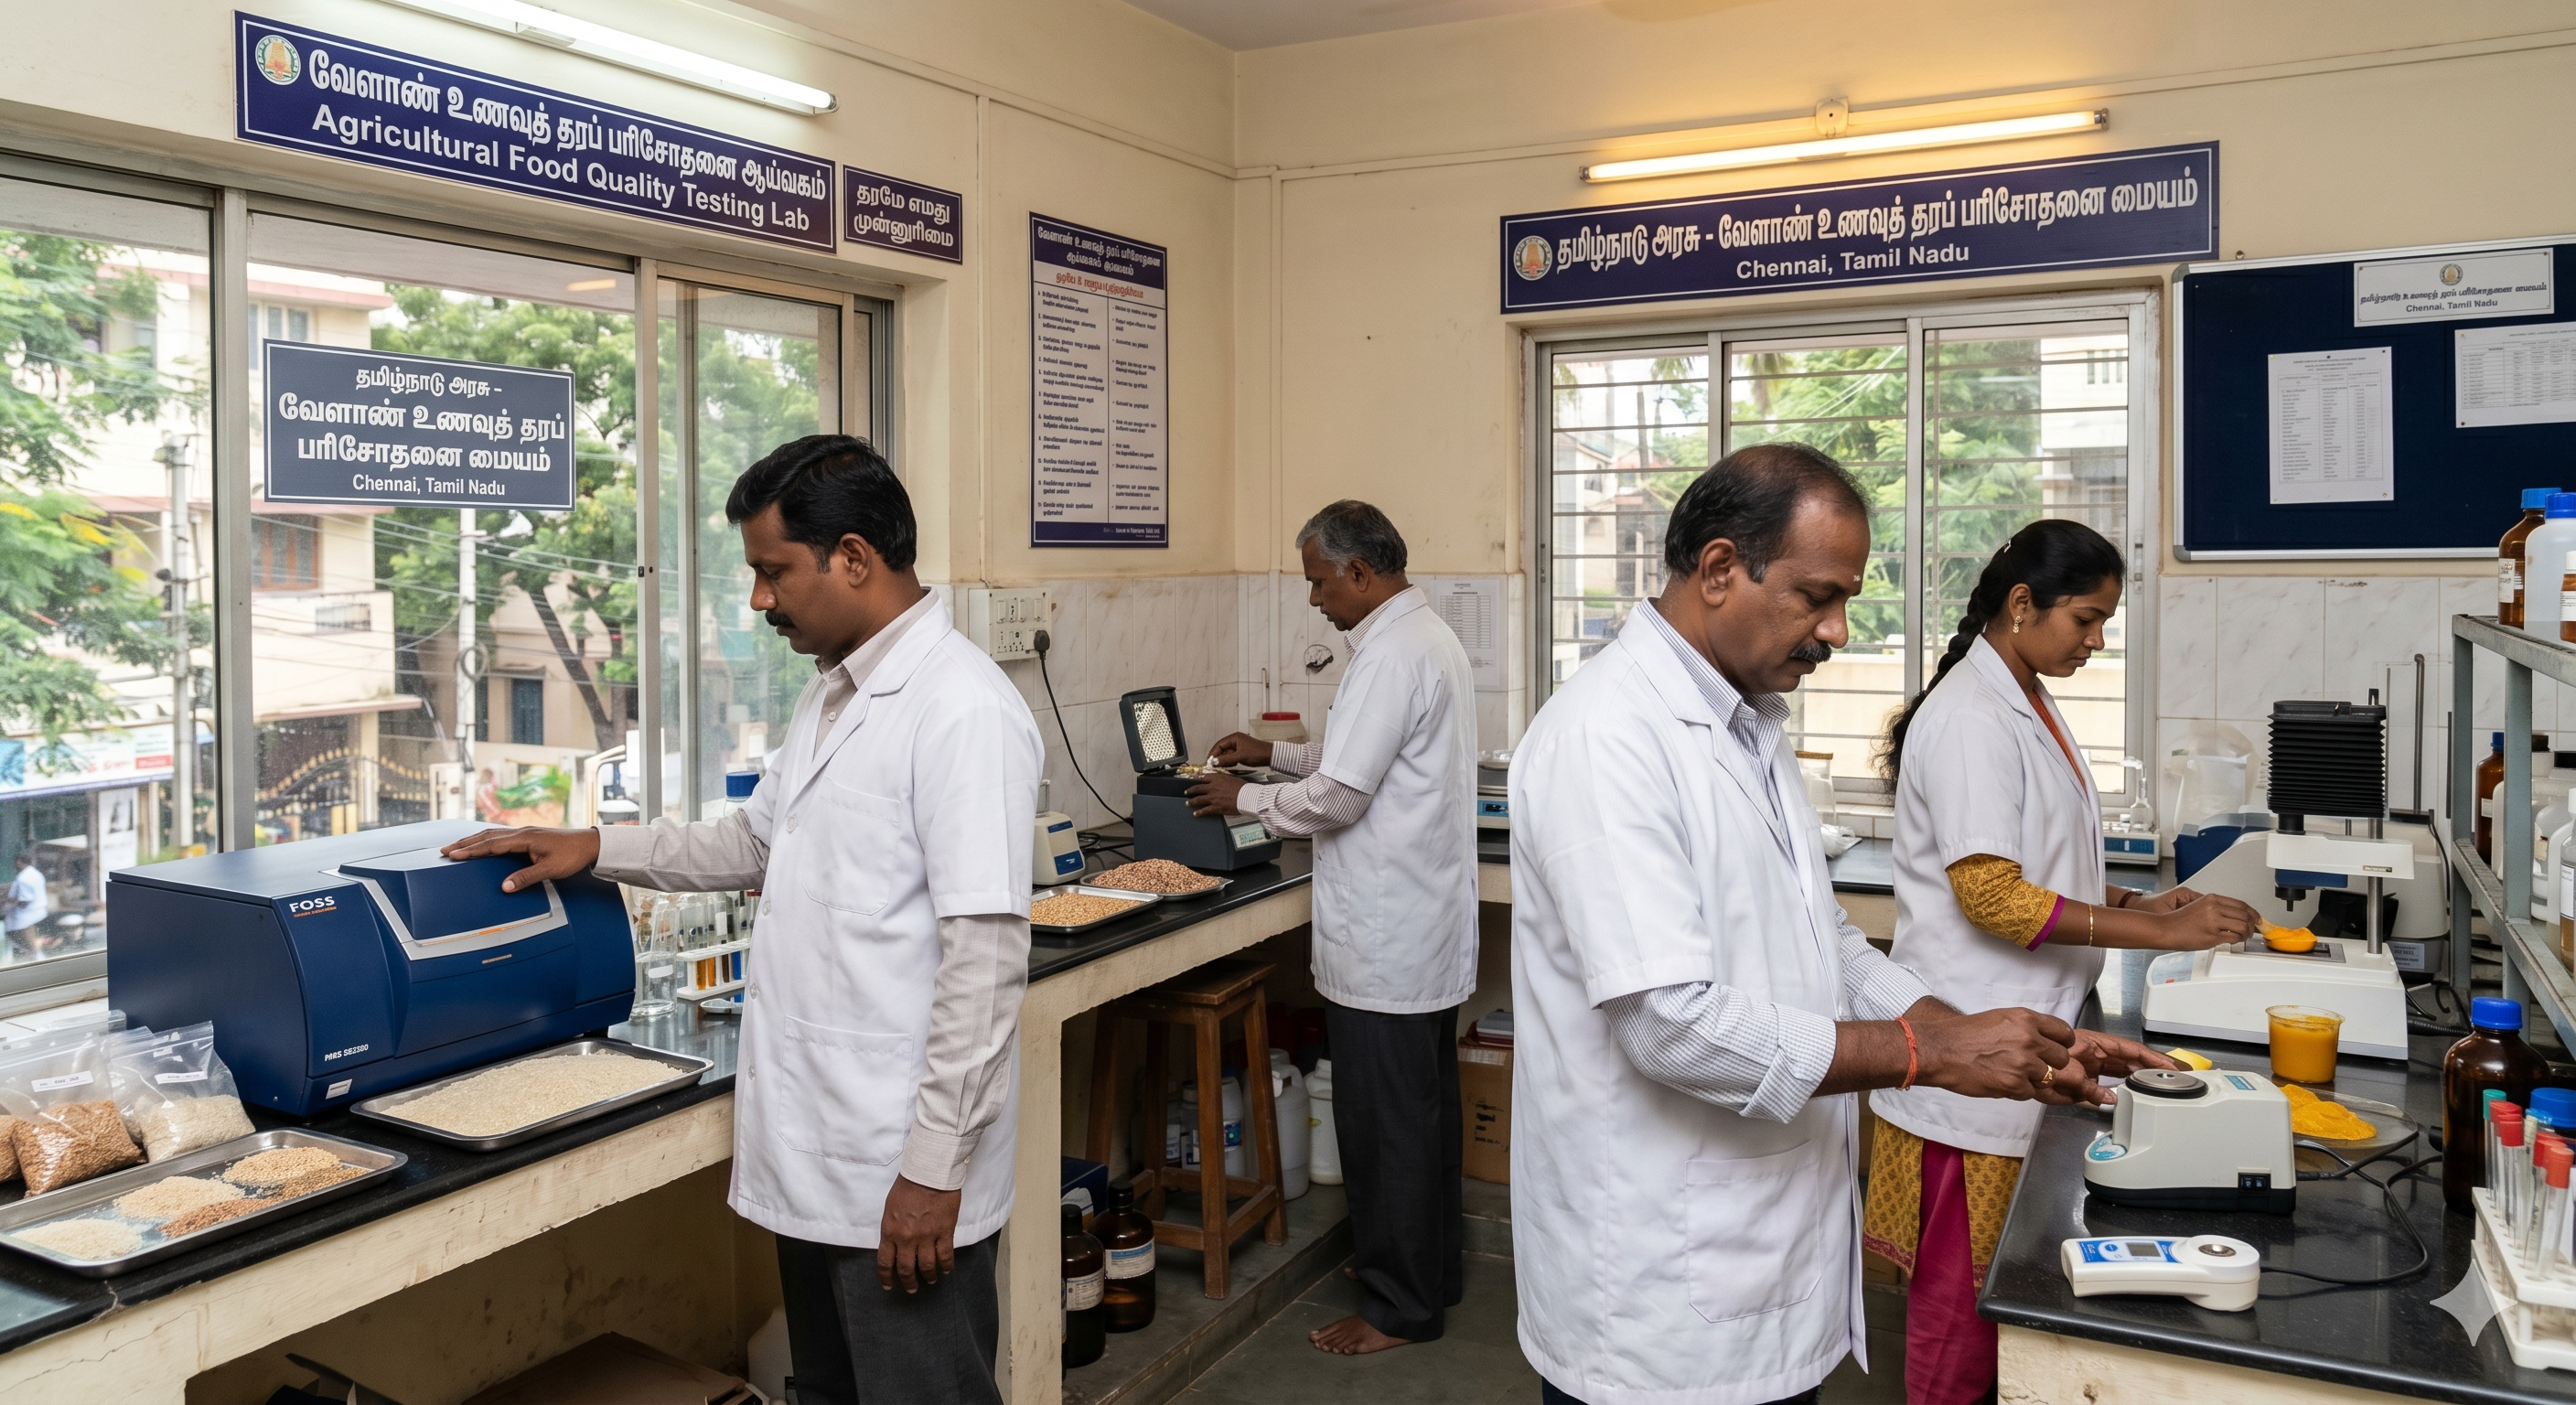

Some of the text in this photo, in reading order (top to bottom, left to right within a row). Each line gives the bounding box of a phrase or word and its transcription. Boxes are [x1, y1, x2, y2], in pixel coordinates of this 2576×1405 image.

[308, 48, 826, 200] வேளாண் உணவுத் தரப் பரிசோதனை ஆய்வகம்
[312, 103, 810, 231] Agricultural Food Quality Testing Lab
[856, 184, 950, 226] தரமே எமது
[1557, 224, 1648, 274] தமிழ்நாடு
[1651, 224, 1701, 260] அரசு
[1719, 204, 1814, 250] வேளாண்
[1818, 195, 1905, 244] உணவுத்
[1911, 189, 1955, 241] தரப்
[1961, 187, 2106, 231] பரிசோதனை
[2111, 166, 2198, 213] மையம்
[853, 210, 954, 248] முன்னுரிமை
[1737, 243, 1970, 279] Chennai, Tamil Nadu
[2474, 299, 2498, 308] Nadu
[356, 365, 445, 397] தமிழ்நாடு
[448, 376, 490, 399] அரசு
[278, 391, 565, 445] வேளாண் உணவுத் தரப்
[297, 432, 551, 472] பரிசோதனை மையம்
[352, 473, 506, 496] Chennai, Tamil Nadu
[289, 896, 335, 912] FOSS
